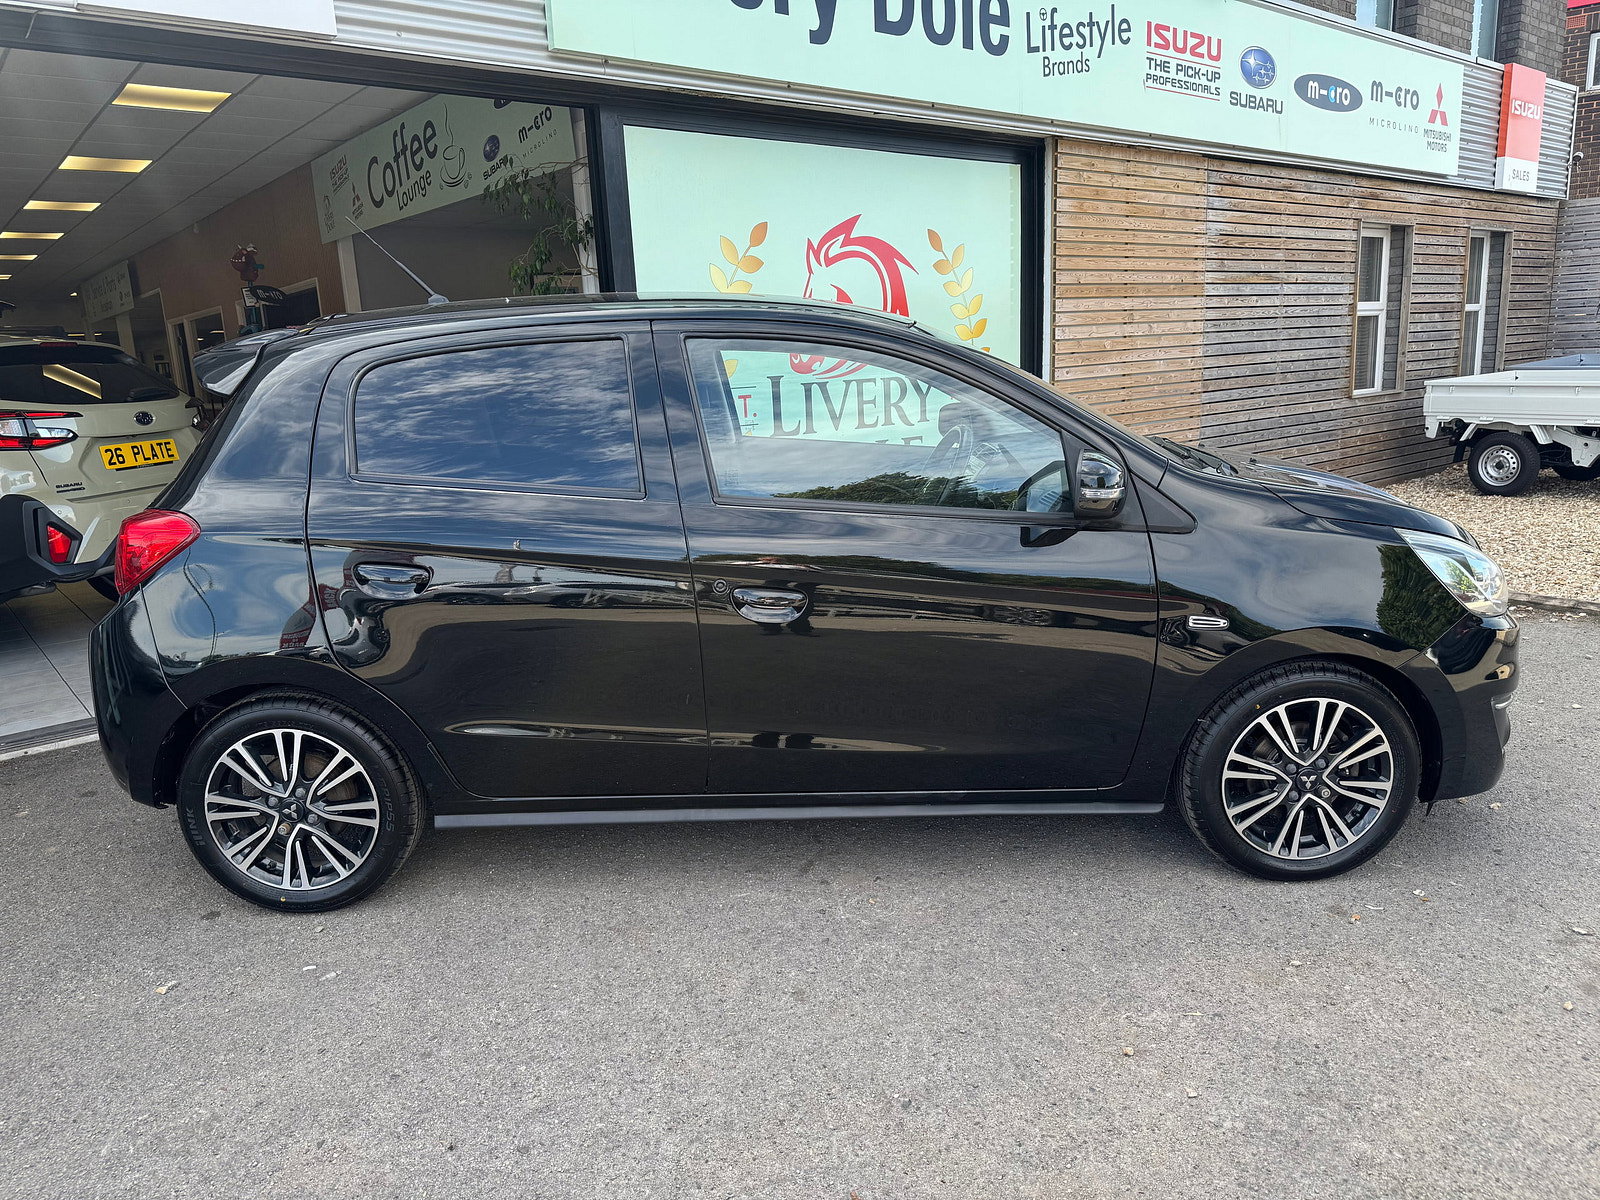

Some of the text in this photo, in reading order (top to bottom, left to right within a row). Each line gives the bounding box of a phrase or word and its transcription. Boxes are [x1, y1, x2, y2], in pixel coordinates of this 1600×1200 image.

[1025, 4, 1132, 58] Lifestyle
[1146, 20, 1222, 62] ISUZU
[1042, 51, 1091, 77] Brands
[1146, 56, 1221, 83] THE PICK-UP
[1145, 73, 1221, 96] PROFESSIONALS
[1229, 91, 1284, 114] SUBARU
[1511, 99, 1541, 120] ISUZU
[1369, 117, 1419, 134] MICROLINO
[1423, 128, 1452, 142] MITSUBISHI
[522, 128, 558, 159] MICROLINO
[1426, 140, 1448, 153] MOTORS
[330, 154, 347, 181] ISUZU
[367, 120, 438, 209] Coffee
[482, 157, 507, 181] SUBAR
[1512, 168, 1530, 182] SALES
[396, 169, 432, 211] Lounge
[766, 376, 933, 438] LIVERY
[104, 441, 175, 466] 26 PLATE
